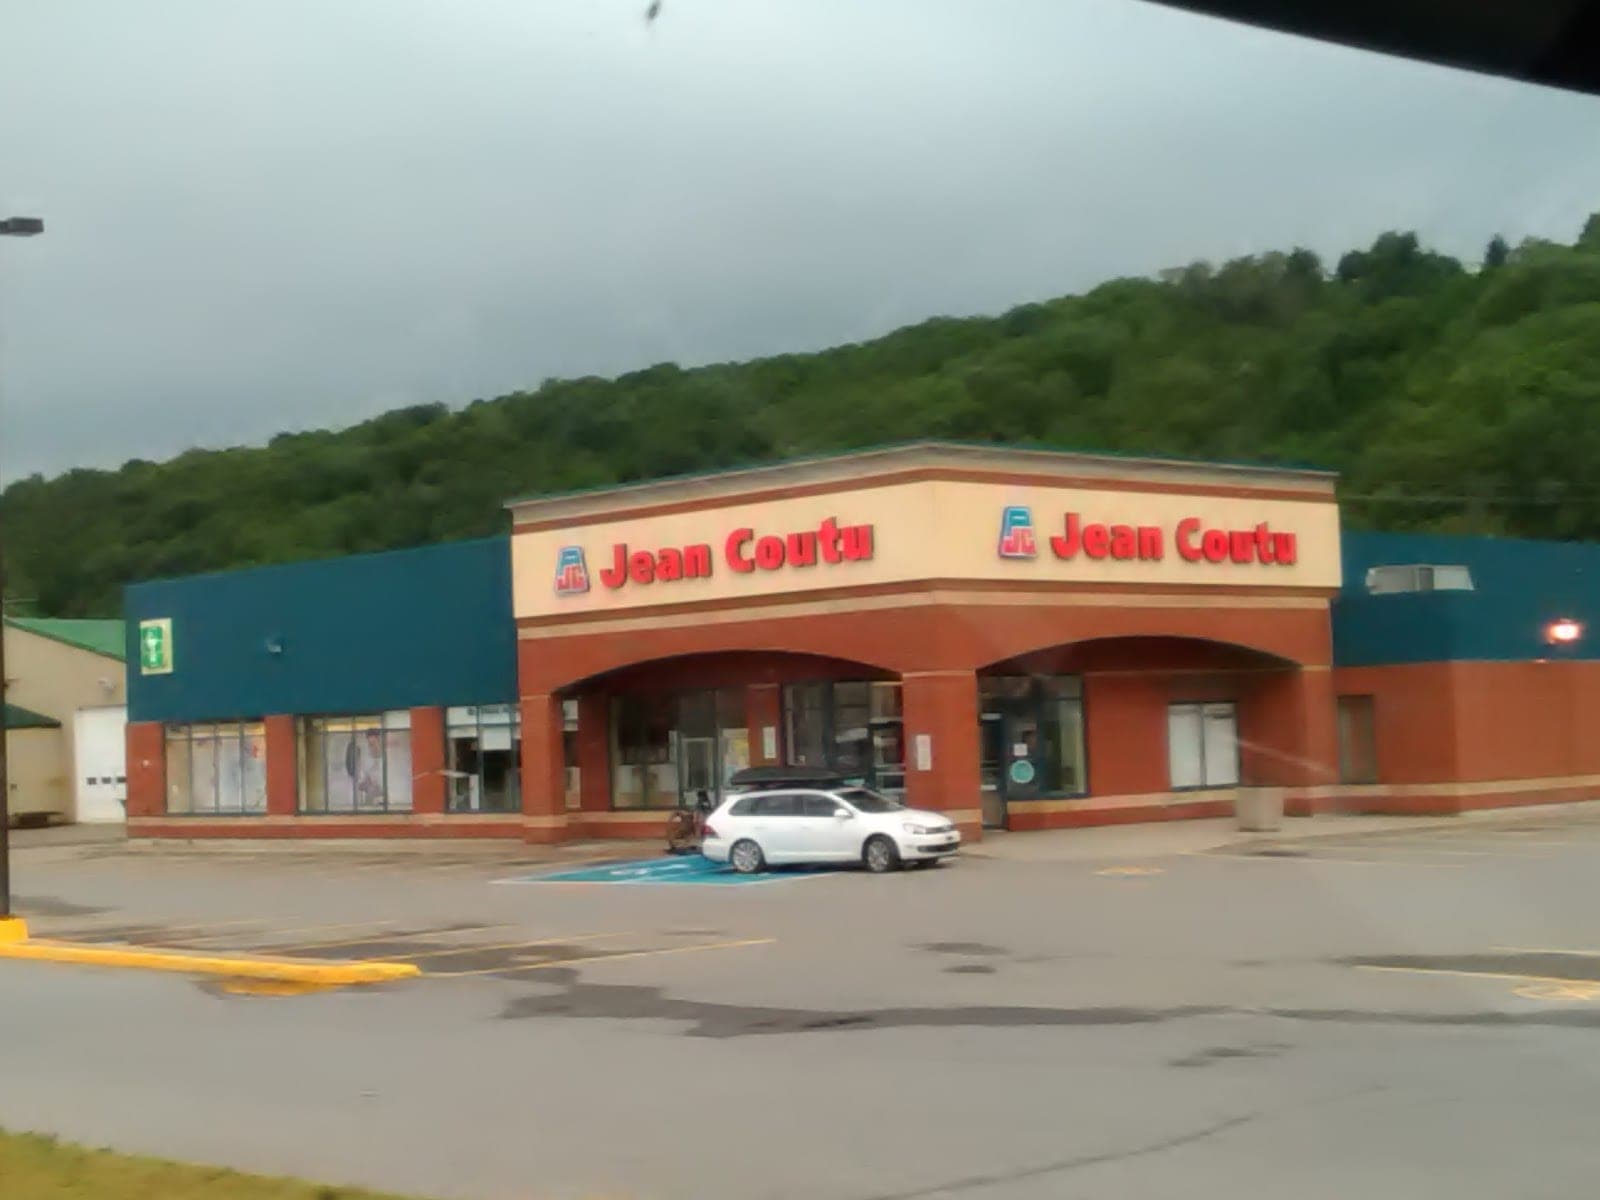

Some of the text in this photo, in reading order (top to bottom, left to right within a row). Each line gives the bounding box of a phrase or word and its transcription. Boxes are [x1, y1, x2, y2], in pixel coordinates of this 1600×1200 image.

[599, 543, 712, 589] Jean
[724, 517, 874, 573] Coutu
[1050, 512, 1164, 560] Jean
[1175, 517, 1297, 565] Coutu
